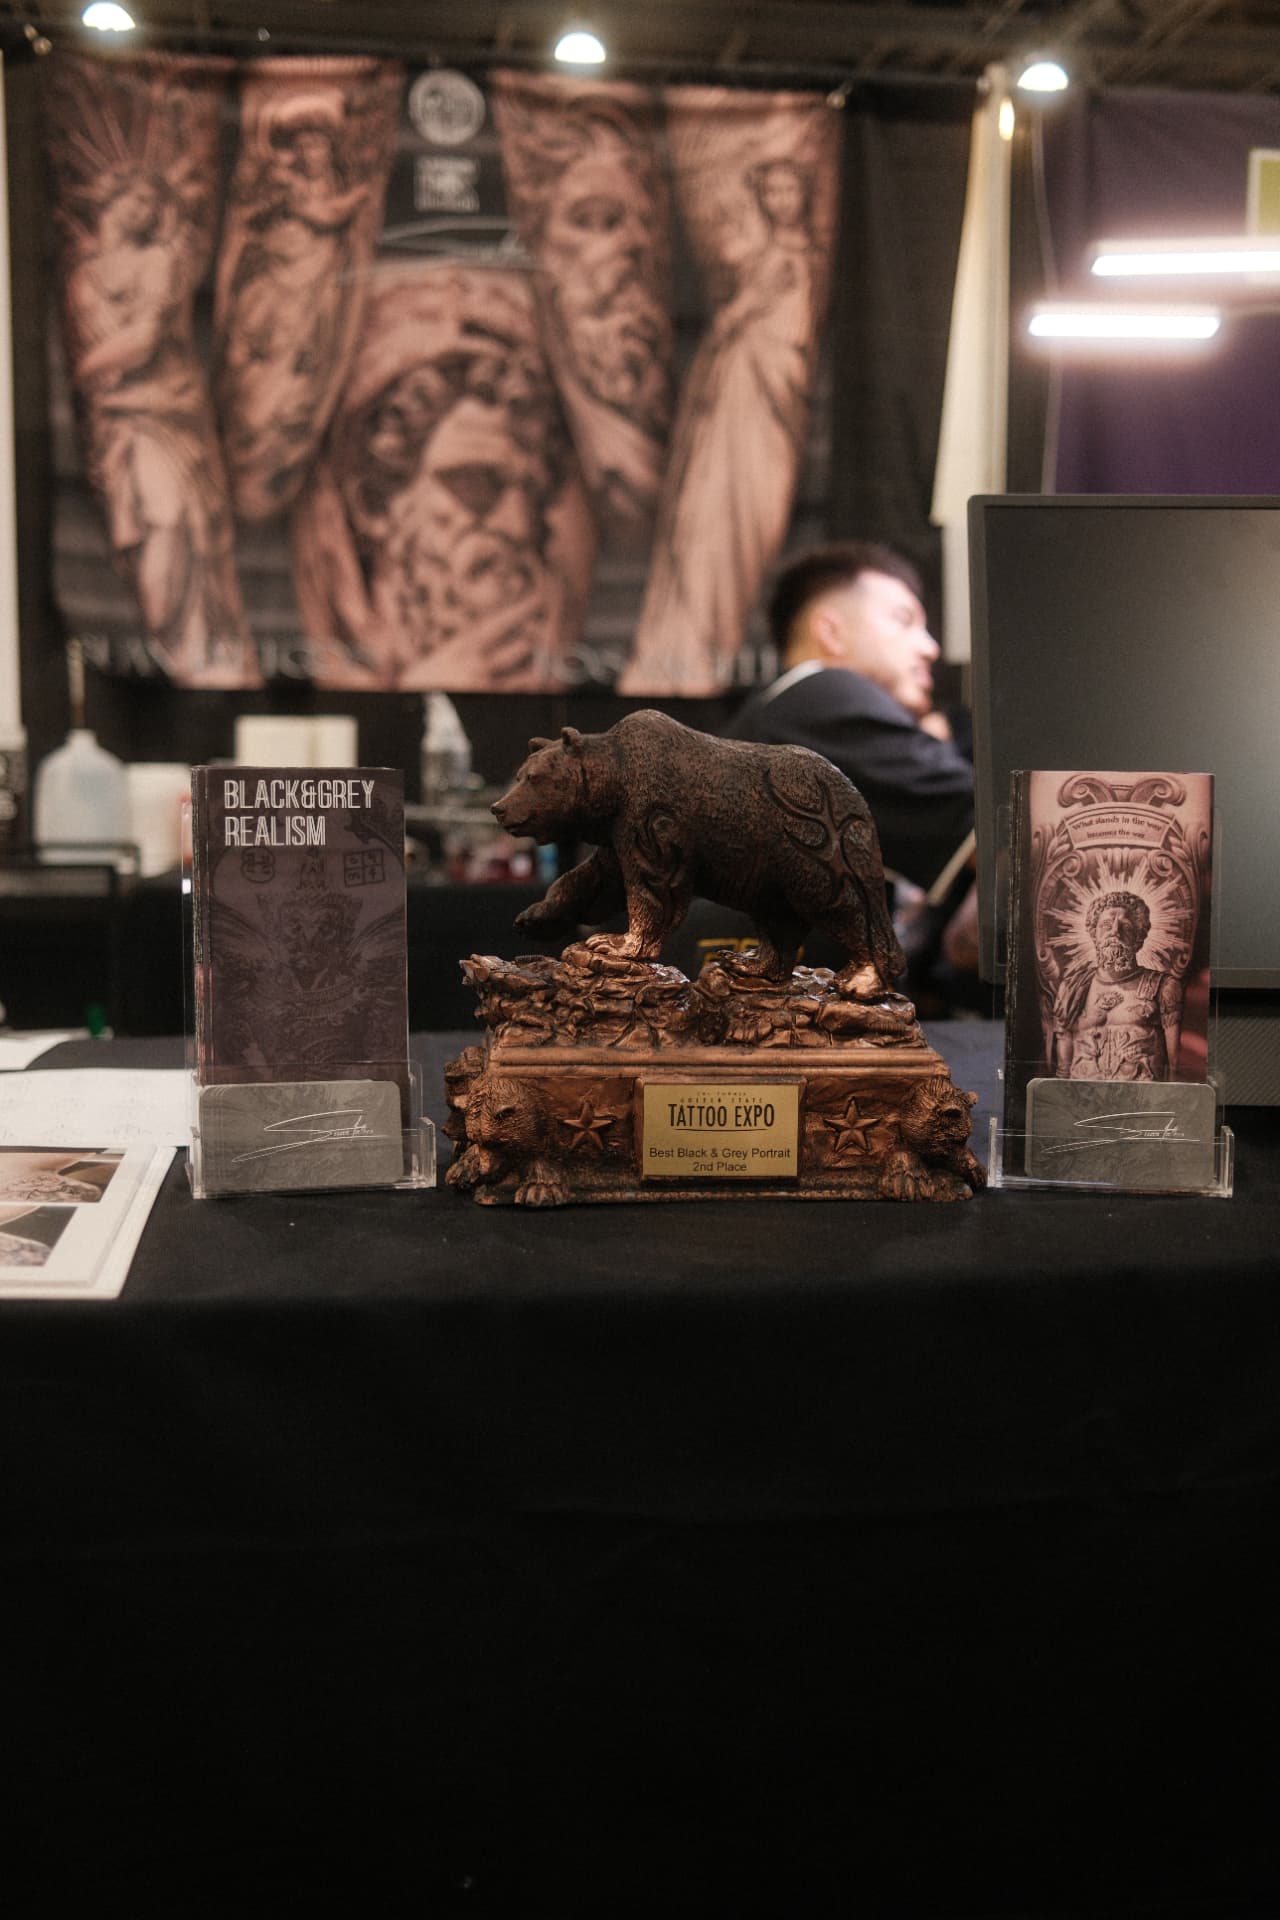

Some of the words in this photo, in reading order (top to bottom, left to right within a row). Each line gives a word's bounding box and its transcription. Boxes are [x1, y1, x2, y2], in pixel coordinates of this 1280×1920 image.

[224, 779, 375, 809] BLACK&GREY
[1072, 819, 1093, 830] What
[1121, 815, 1130, 824] in
[1132, 816, 1145, 825] the
[225, 816, 326, 847] REALISM
[1118, 828, 1130, 836] the
[668, 1104, 727, 1127] TATTOO
[735, 1104, 775, 1127] EXPO
[649, 1148, 674, 1158] Best
[677, 1148, 706, 1158] Black
[710, 1148, 718, 1158] &
[722, 1148, 747, 1160] Grey
[751, 1148, 791, 1158] Portrait
[693, 1162, 713, 1172] 2nd
[717, 1162, 747, 1172] Place
